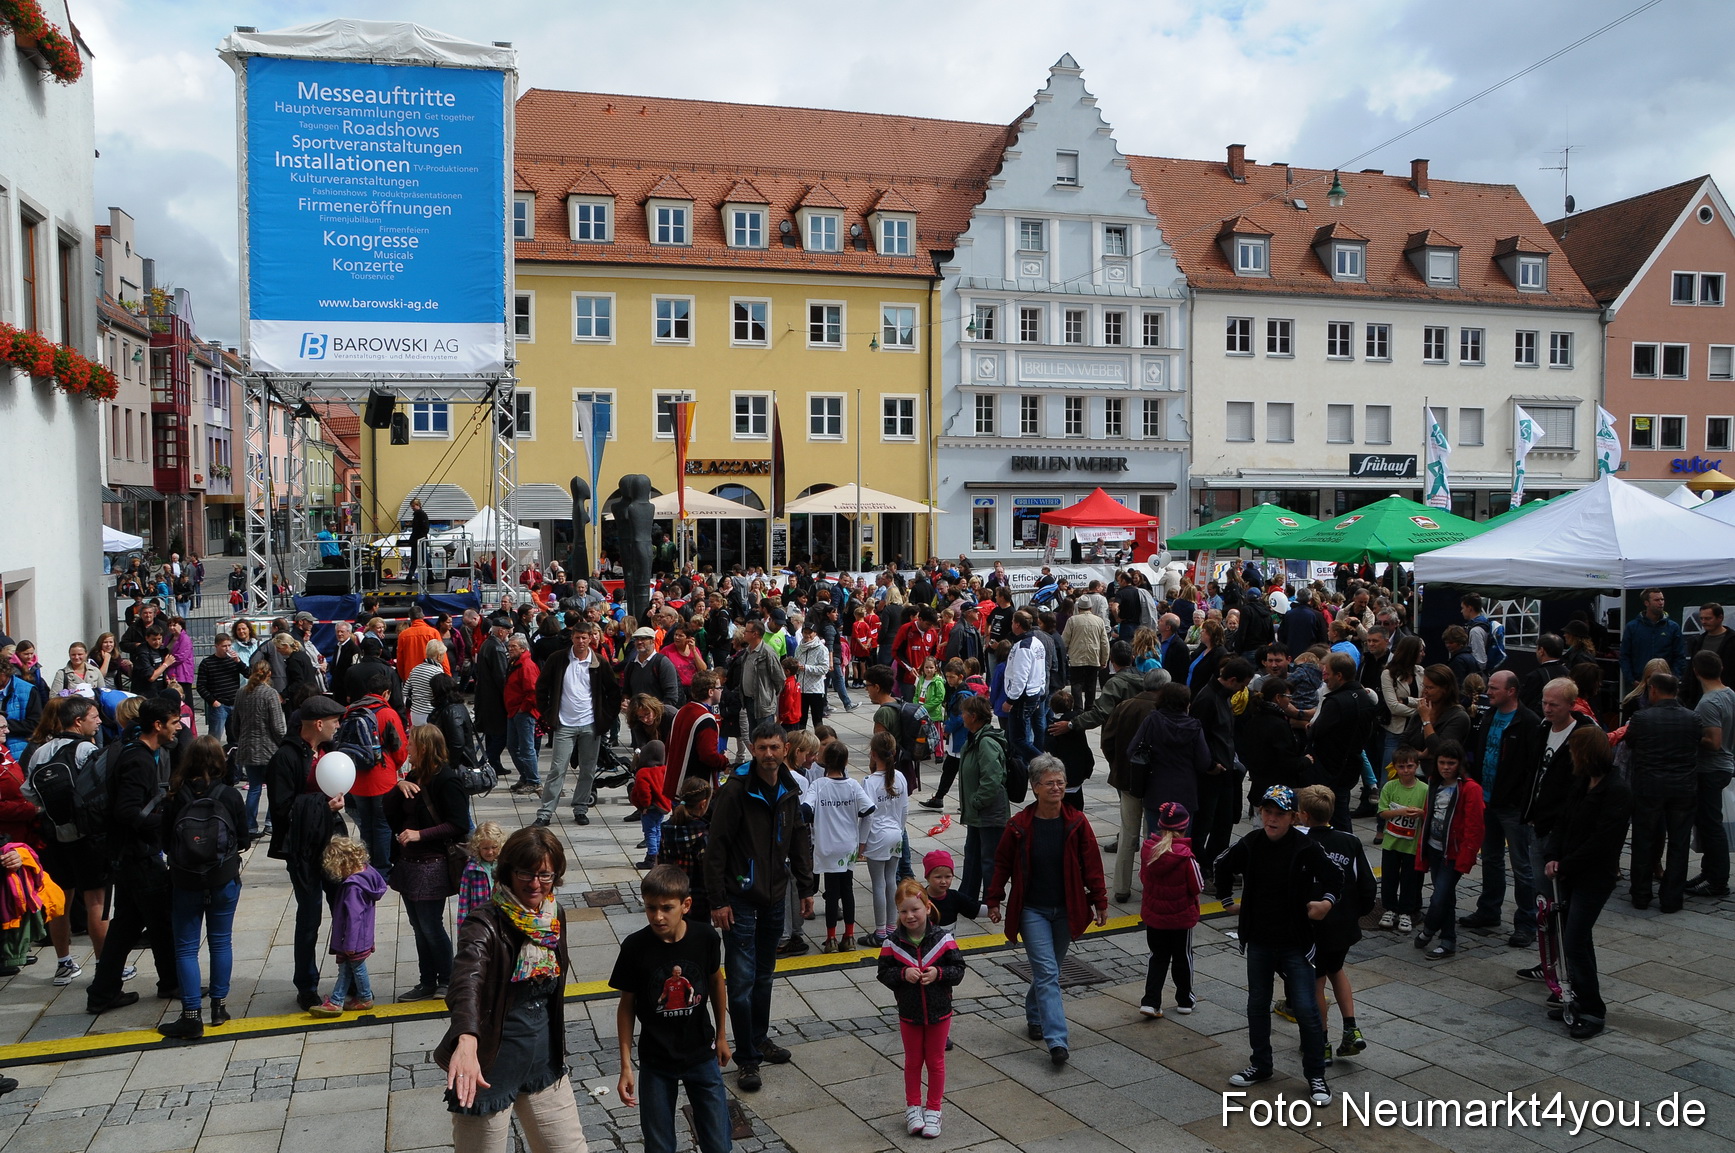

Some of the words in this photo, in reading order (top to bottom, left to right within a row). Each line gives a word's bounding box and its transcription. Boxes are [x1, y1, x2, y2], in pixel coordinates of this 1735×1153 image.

[298, 81, 456, 107] Messeauftritte
[274, 101, 421, 122] Hauptversammlungen
[424, 112, 439, 121] Get
[440, 113, 475, 122] together
[299, 120, 339, 131] Tagungen
[342, 120, 440, 138] Roadshows
[292, 134, 463, 158] Sportveranstaltungen
[275, 151, 410, 173] Installationen
[413, 163, 479, 173] TV-Produktionen
[290, 172, 419, 189] Kulturveranstaltungen
[312, 187, 367, 197] Fashionshows
[372, 189, 463, 200] Produktpräsentationen
[298, 197, 452, 218] Firmeneröffnungen
[319, 214, 382, 224] Firmenjubiläum
[379, 225, 430, 234] Firmenfeiern
[323, 230, 419, 251] Kongresse
[373, 250, 414, 260] Musicals
[332, 257, 404, 273] Konzerte
[351, 272, 394, 281] Tourservice
[318, 297, 439, 312] www.barowski-ag.de
[333, 337, 427, 352] BAROWSKI
[433, 338, 459, 353] AG
[333, 353, 387, 361] Veranstaltungs-
[405, 353, 458, 361] Mediensysteme
[1024, 361, 1075, 376] BRILLEN
[1077, 363, 1122, 377] WEBER
[1011, 455, 1071, 471] BRILLEN
[1073, 456, 1130, 472] WEBER
[1353, 455, 1415, 476] frühauf
